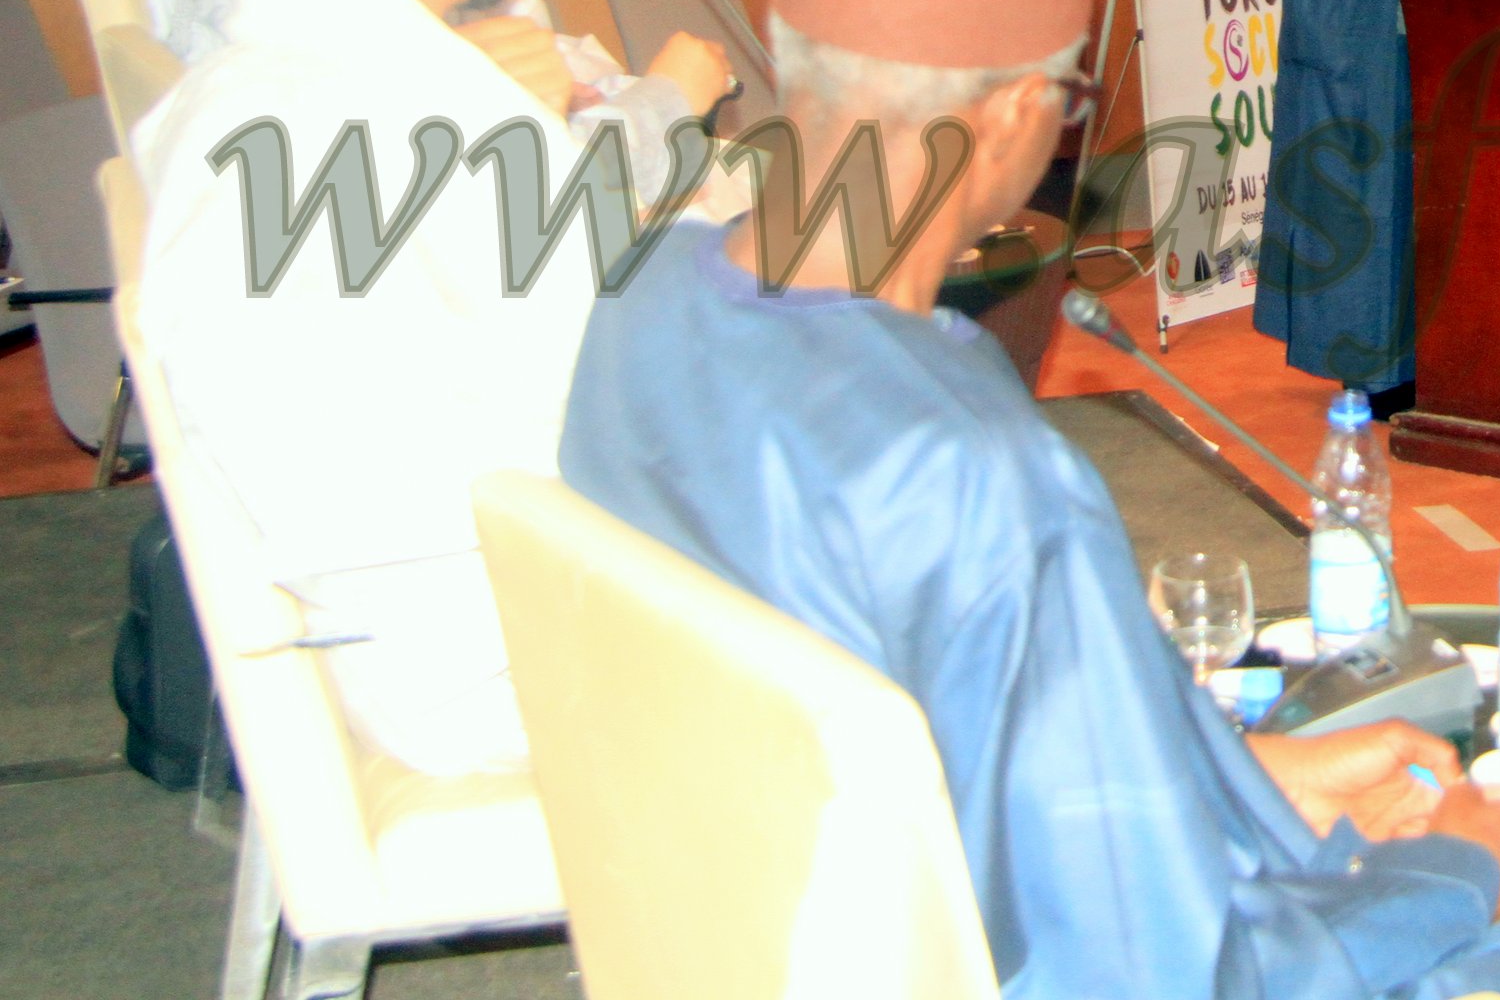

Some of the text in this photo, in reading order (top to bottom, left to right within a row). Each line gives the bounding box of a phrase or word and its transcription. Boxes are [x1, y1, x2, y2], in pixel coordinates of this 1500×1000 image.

[1197, 184, 1217, 215] DU
[1222, 179, 1236, 208] 15
[1241, 175, 1257, 203] AU
